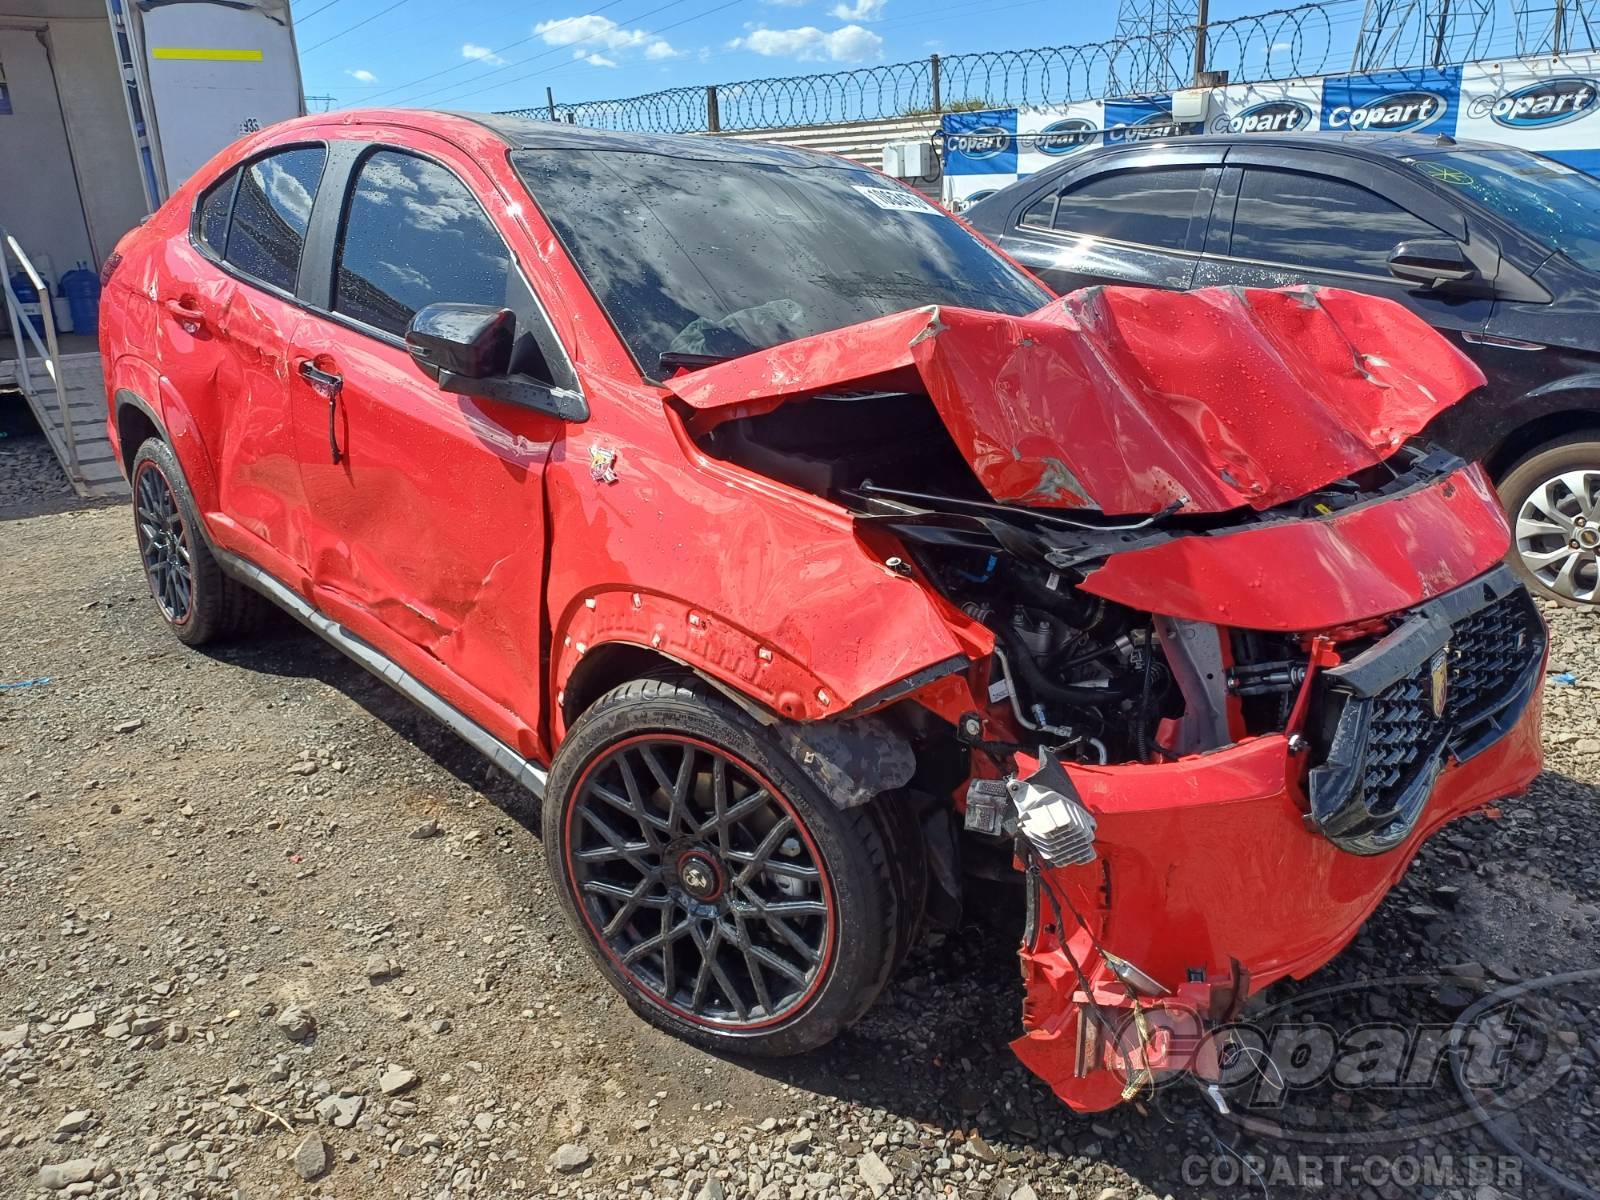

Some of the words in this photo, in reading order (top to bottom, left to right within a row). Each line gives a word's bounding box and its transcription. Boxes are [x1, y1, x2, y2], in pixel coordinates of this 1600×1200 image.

[1328, 98, 1433, 129] Copart
[1467, 87, 1589, 120] Copart
[1211, 108, 1298, 134] Copart
[947, 132, 1002, 152] Copart
